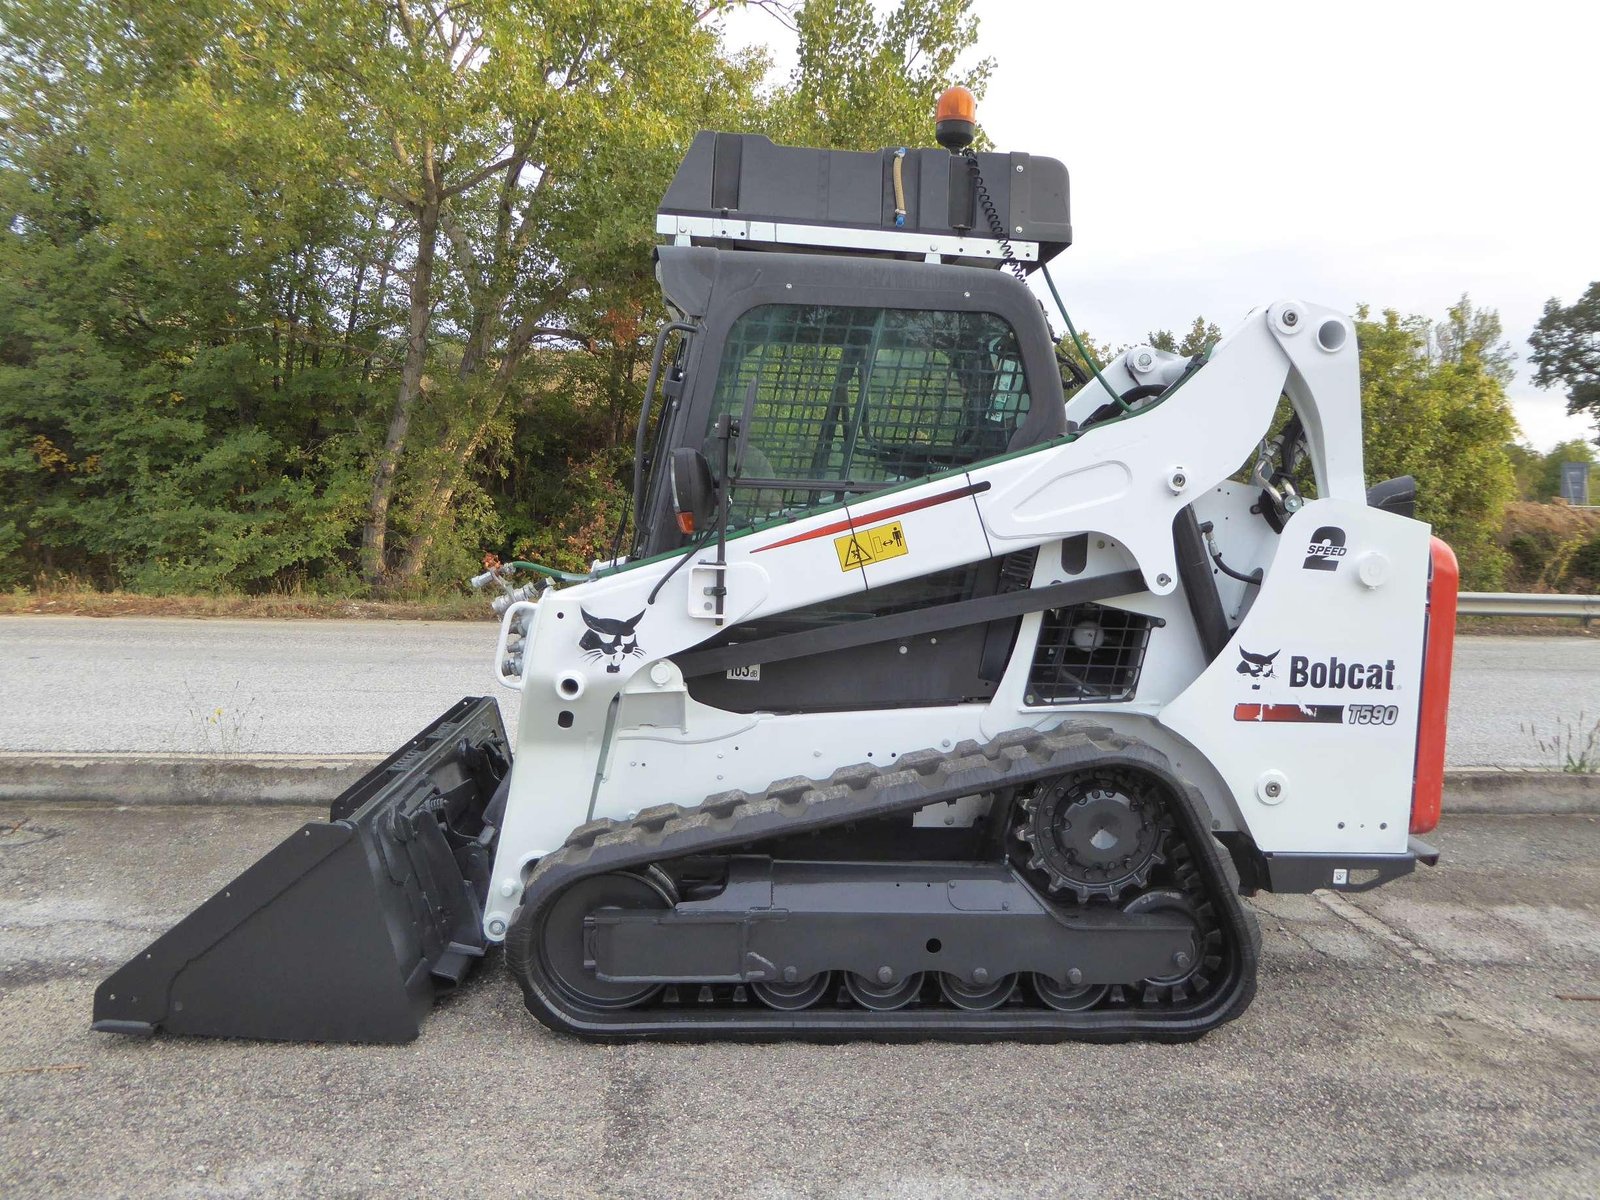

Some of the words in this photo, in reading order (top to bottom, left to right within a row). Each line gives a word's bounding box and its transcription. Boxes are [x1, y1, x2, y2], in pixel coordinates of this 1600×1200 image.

[1303, 525, 1346, 571] 2
[1307, 544, 1347, 557] SPEED
[1289, 655, 1396, 690] Bobcat
[1348, 704, 1398, 725] T590
